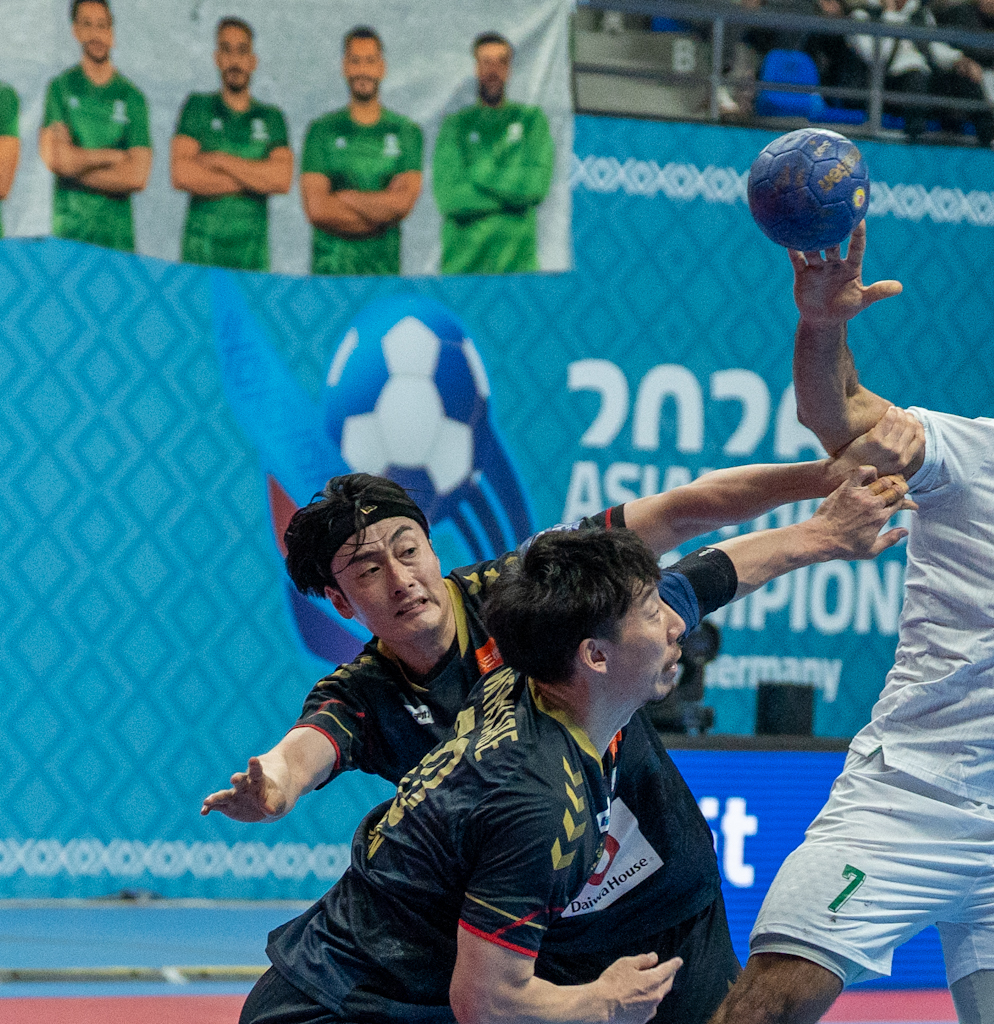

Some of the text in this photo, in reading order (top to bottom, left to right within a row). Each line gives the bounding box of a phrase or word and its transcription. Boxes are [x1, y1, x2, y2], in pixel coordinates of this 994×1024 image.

[570, 858, 649, 913] Daiwa House
[828, 864, 867, 913] 7
